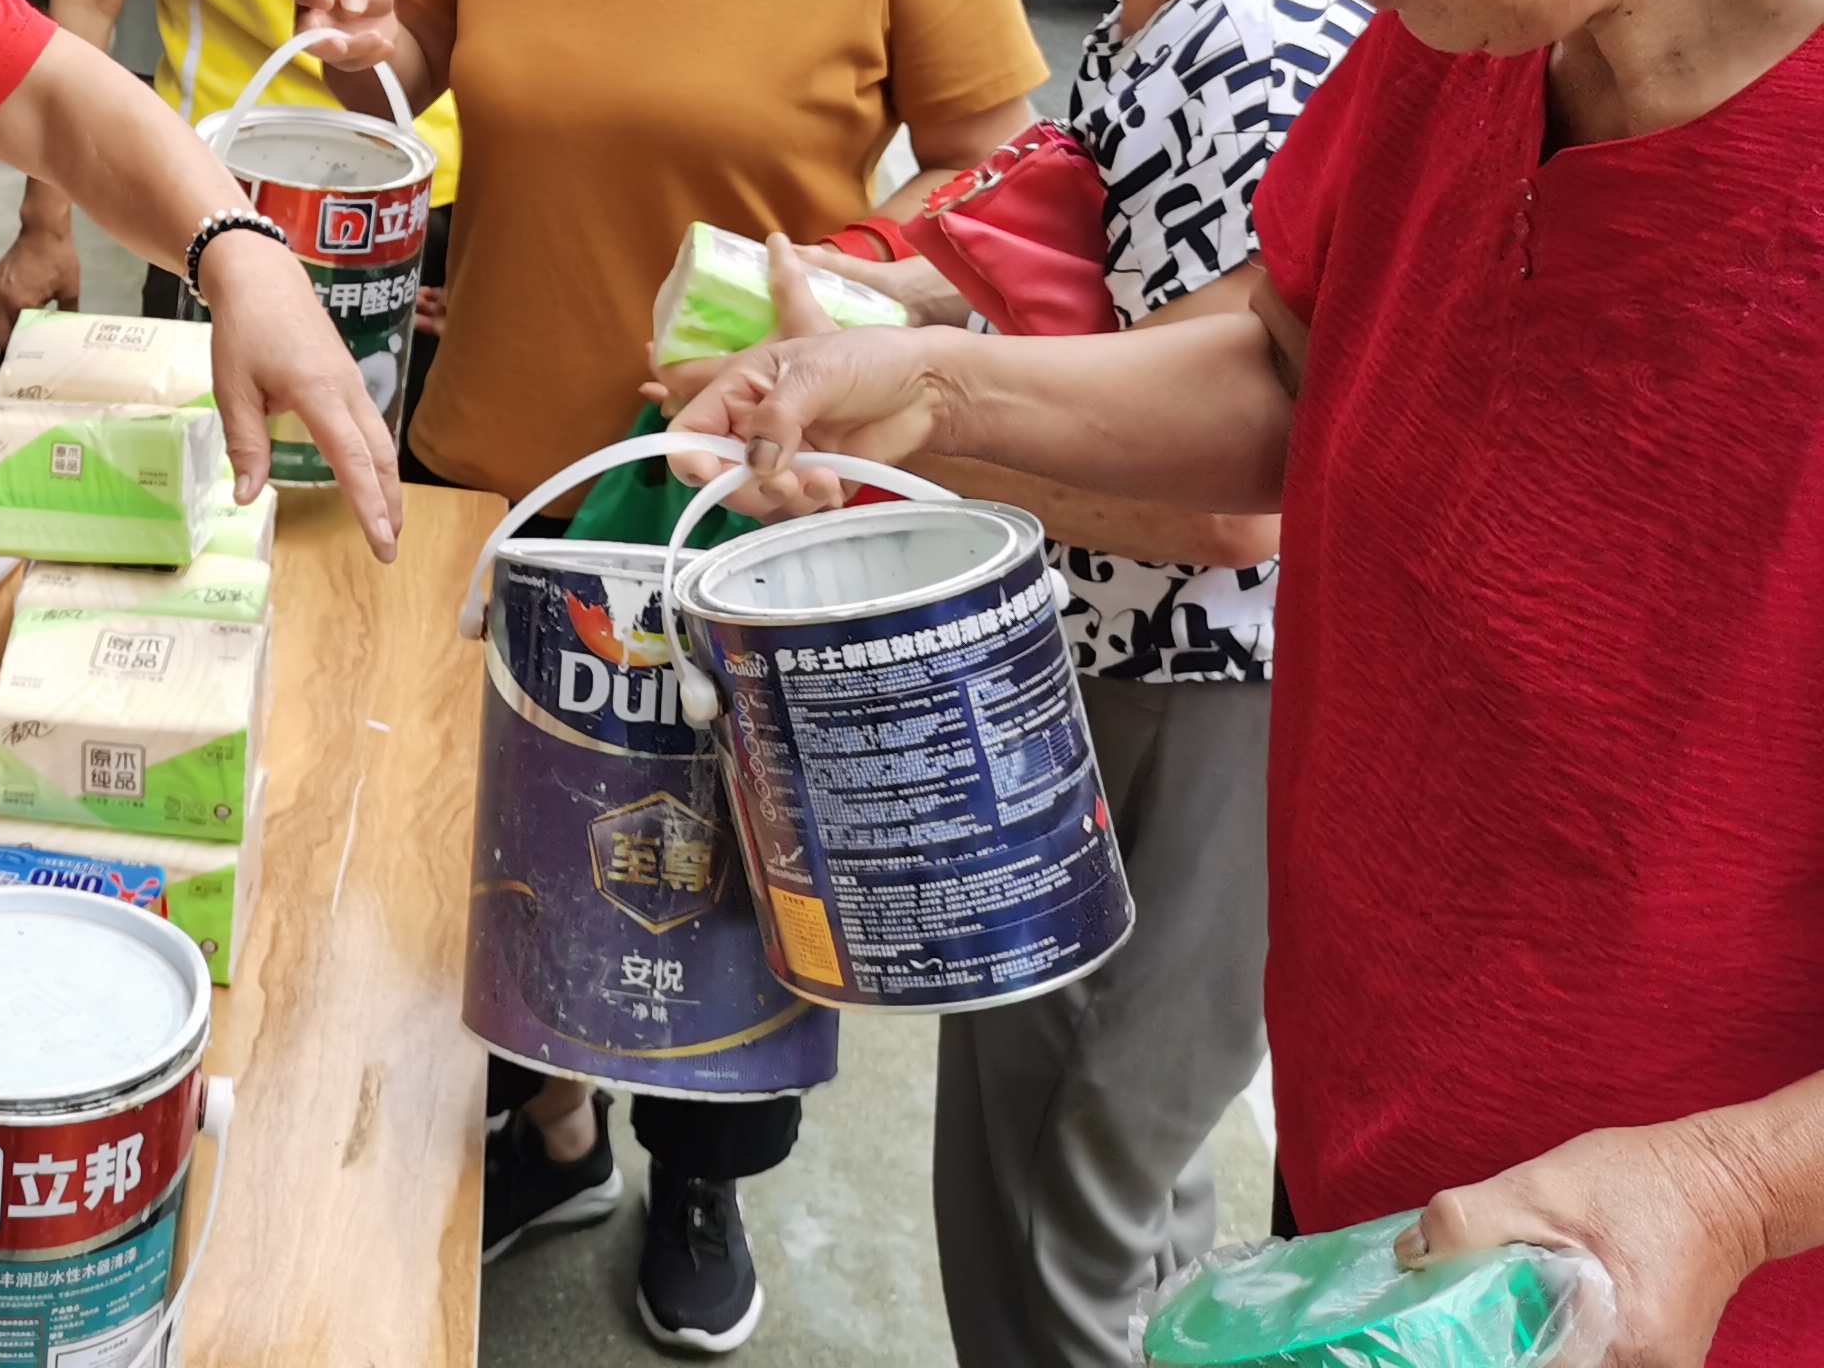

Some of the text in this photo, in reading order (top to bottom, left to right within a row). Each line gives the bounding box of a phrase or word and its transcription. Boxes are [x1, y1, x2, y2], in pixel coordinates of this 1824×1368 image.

[558, 649, 679, 726] Dul
[621, 951, 685, 992] 安悦
[7, 1132, 144, 1218] 立邦
